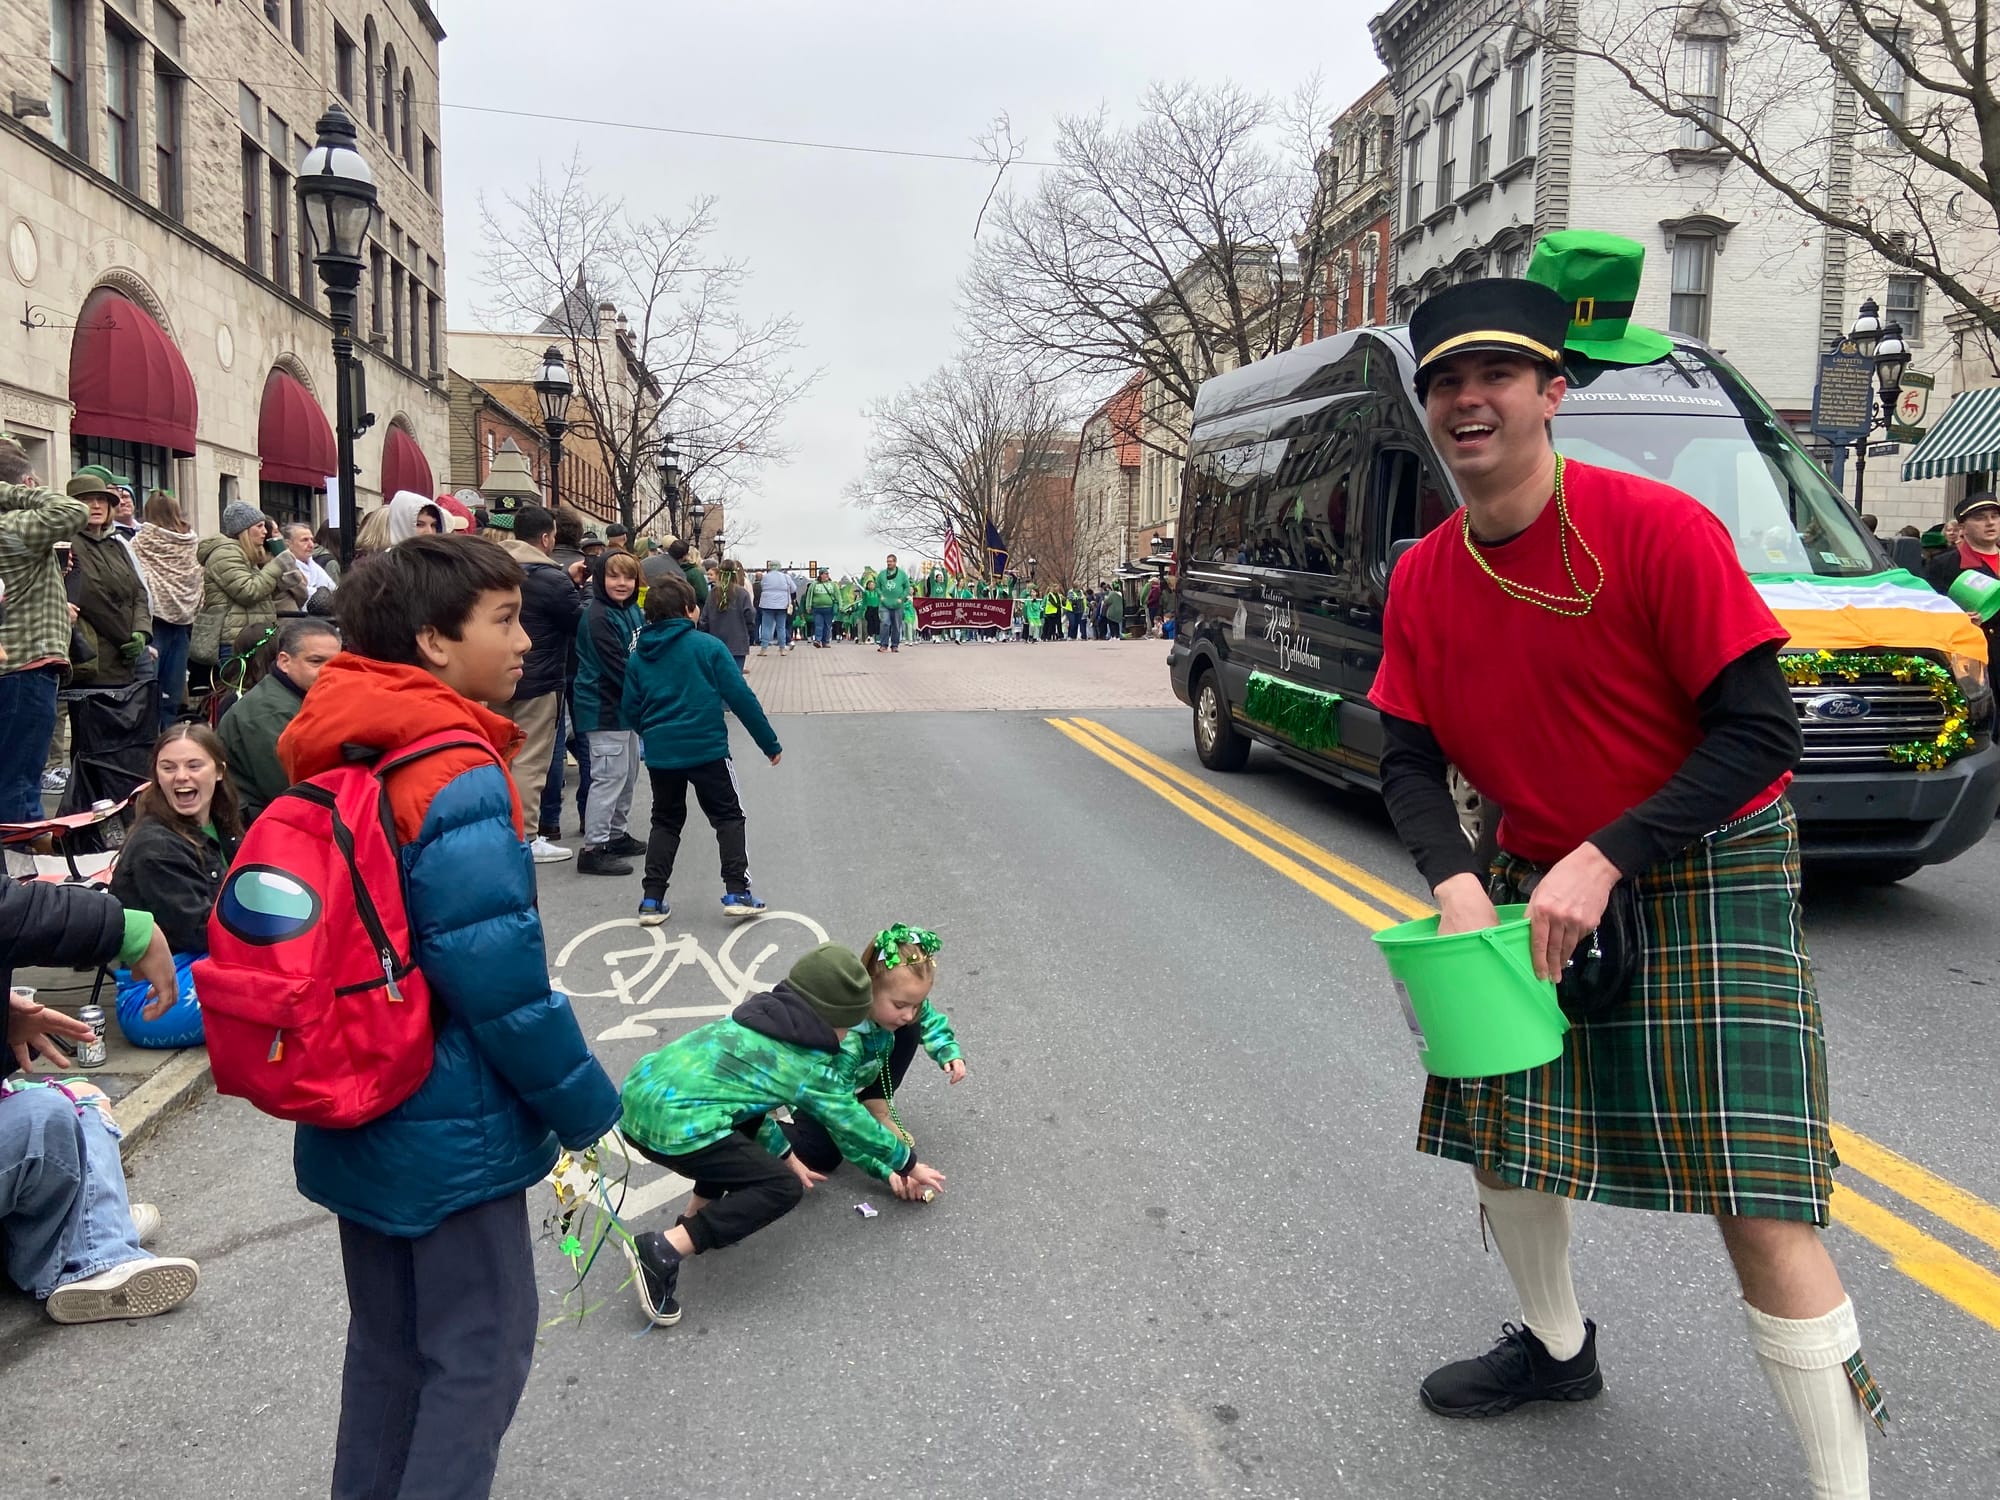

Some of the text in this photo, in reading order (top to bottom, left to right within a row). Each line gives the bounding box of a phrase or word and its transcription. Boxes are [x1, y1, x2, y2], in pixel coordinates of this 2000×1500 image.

[1571, 392, 1628, 401] HOTEL
[1627, 393, 1724, 407] BETHLEHEM
[982, 604, 1007, 615] SCHOOL
[1263, 600, 1291, 642] Hotel
[1273, 630, 1321, 672] Bethlehem
[1829, 700, 1861, 715] Ford
